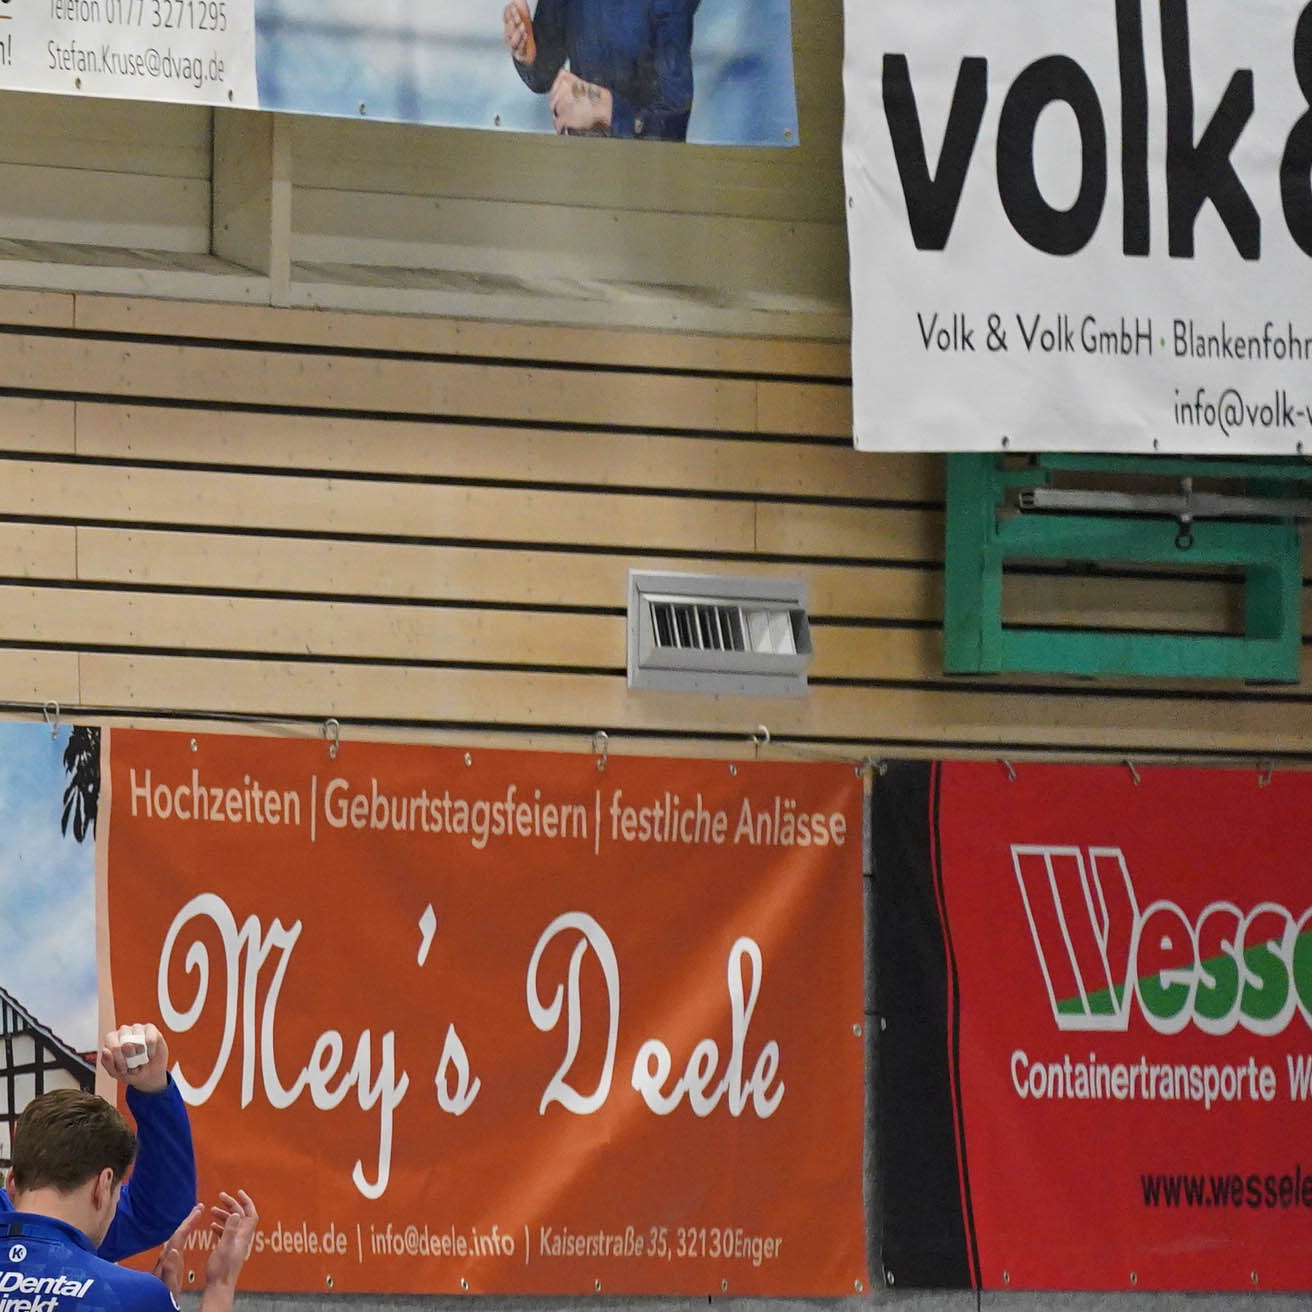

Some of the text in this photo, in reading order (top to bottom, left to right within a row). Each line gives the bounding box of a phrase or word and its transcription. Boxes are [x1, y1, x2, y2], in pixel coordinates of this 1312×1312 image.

[48, 39, 225, 88] Stefan.Kruse@dvag.de
[917, 312, 976, 352] Volk
[986, 313, 1008, 351] &
[1016, 313, 1075, 353] Volk
[1080, 316, 1153, 356] GmbH
[130, 768, 846, 849] Hochzeiten Geburtstagsfeiern festliche Anlässe
[157, 891, 785, 1199] Mey's Deele
[1010, 1049, 1276, 1111] Containertransporte
[371, 1224, 515, 1257] info@deele.info
[539, 1226, 644, 1257] Kaiserstraße
